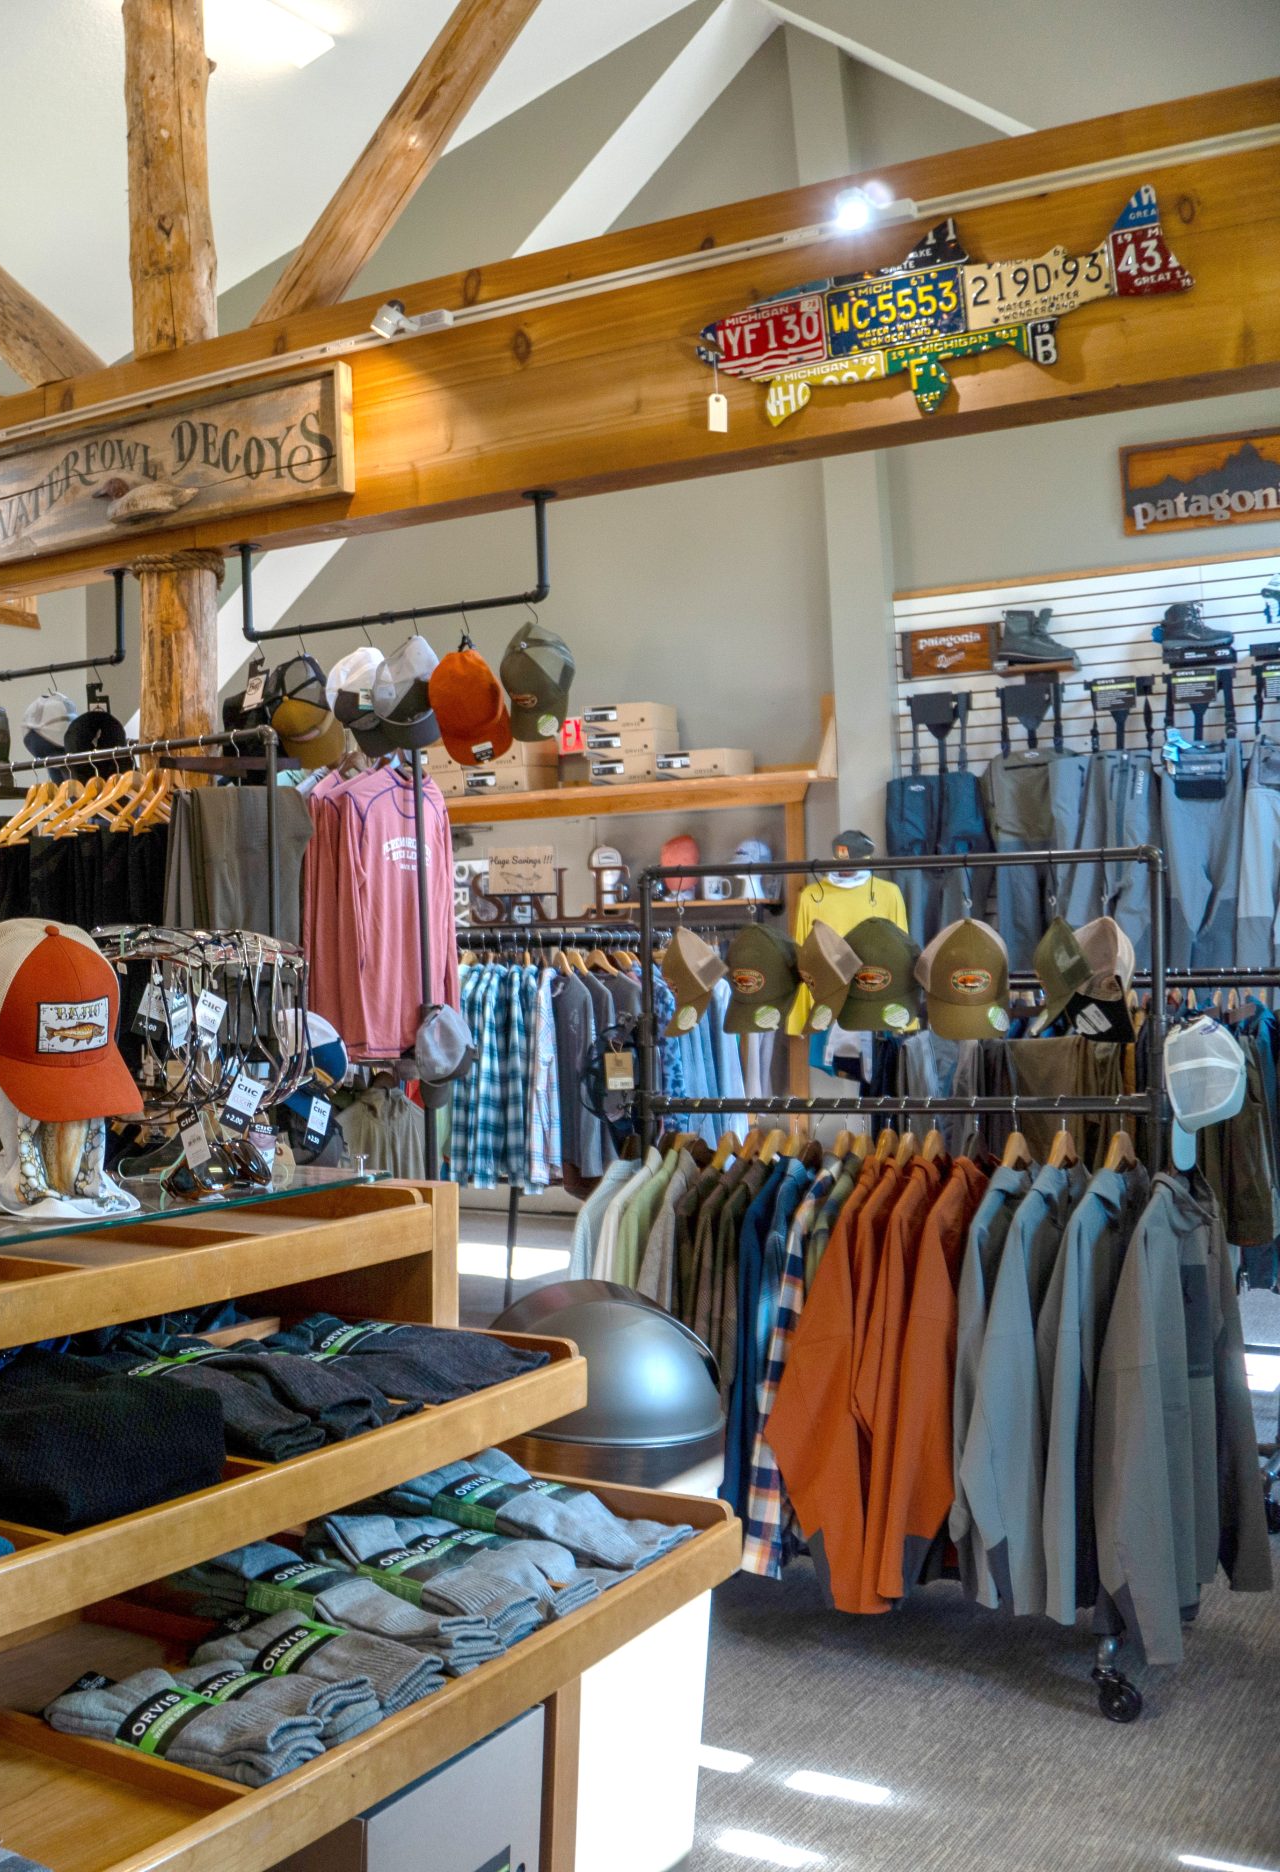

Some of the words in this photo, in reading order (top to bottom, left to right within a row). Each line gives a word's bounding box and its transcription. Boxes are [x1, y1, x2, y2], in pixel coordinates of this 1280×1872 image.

[858, 284, 893, 297] MICH
[910, 277, 925, 287] 67
[1134, 272, 1170, 287] GREAT
[725, 305, 789, 327] MICHIGAN
[918, 334, 990, 355] MICHIGAN
[1035, 333, 1057, 365] B
[783, 362, 850, 383] MICHIGAN
[170, 409, 336, 484] DECOYS
[918, 631, 981, 650] patagonia
[489, 855, 510, 869] Huge
[511, 856, 541, 869] Savings
[320, 1324, 354, 1349] ORVIS
[454, 1475, 492, 1497] ORVIS
[262, 1627, 309, 1672] ORVIS
[131, 1692, 182, 1738] ORVIS
